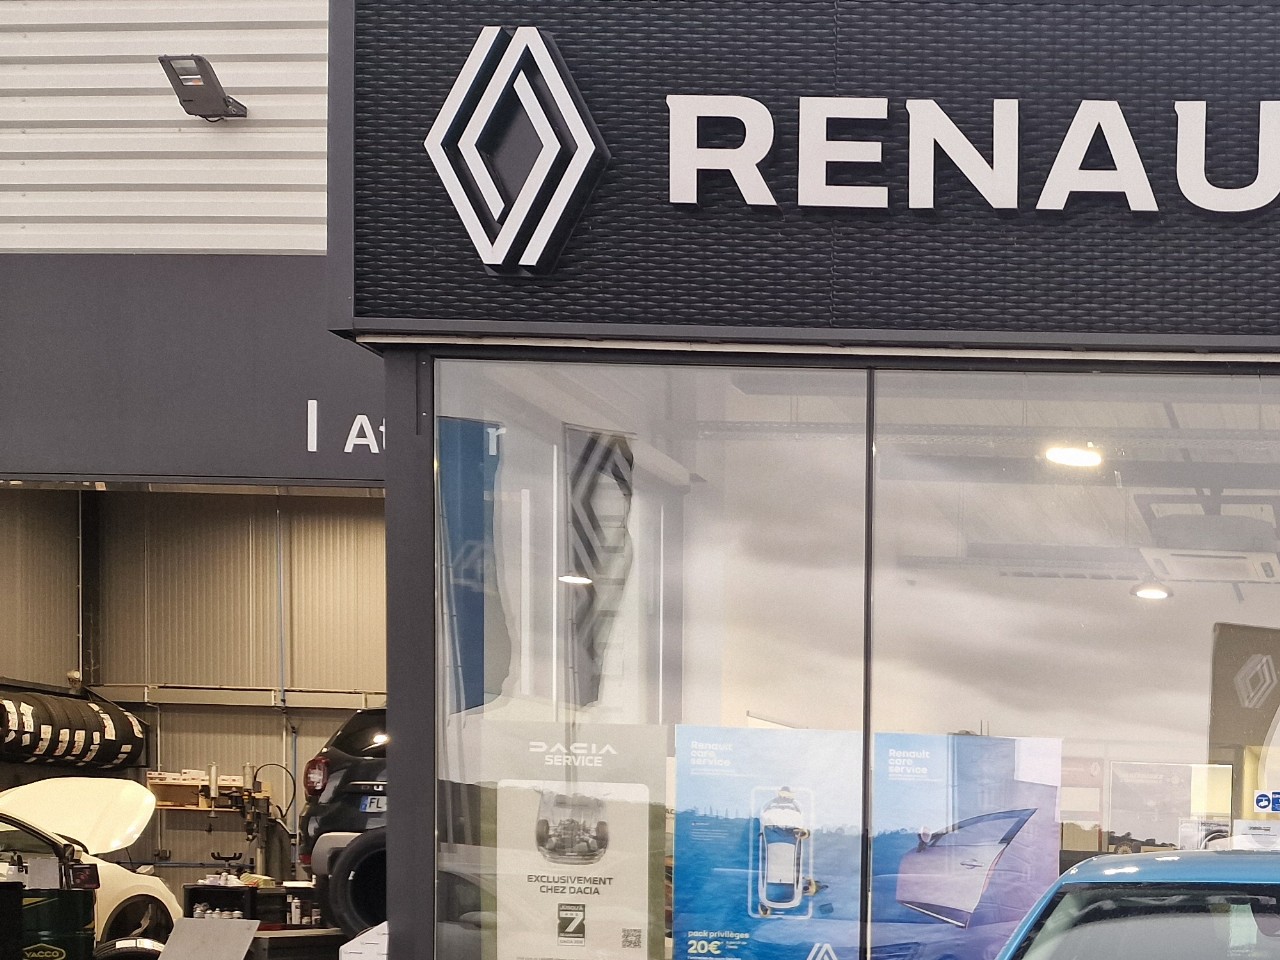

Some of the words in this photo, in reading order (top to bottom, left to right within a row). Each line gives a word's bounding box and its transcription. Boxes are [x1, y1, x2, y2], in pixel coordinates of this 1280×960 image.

[528, 741, 618, 754] DACIA
[690, 740, 734, 751] Renault
[690, 750, 716, 758] care
[888, 748, 931, 759] Renault
[544, 754, 603, 767] SERVICE
[690, 758, 732, 767] service
[888, 758, 913, 766] care
[888, 766, 928, 774] service
[526, 874, 614, 886] EXCLUSIVEMENT
[539, 885, 567, 894] CHEZ
[568, 886, 601, 896] DACIA
[687, 930, 708, 938] pack
[708, 930, 750, 940] privilèges
